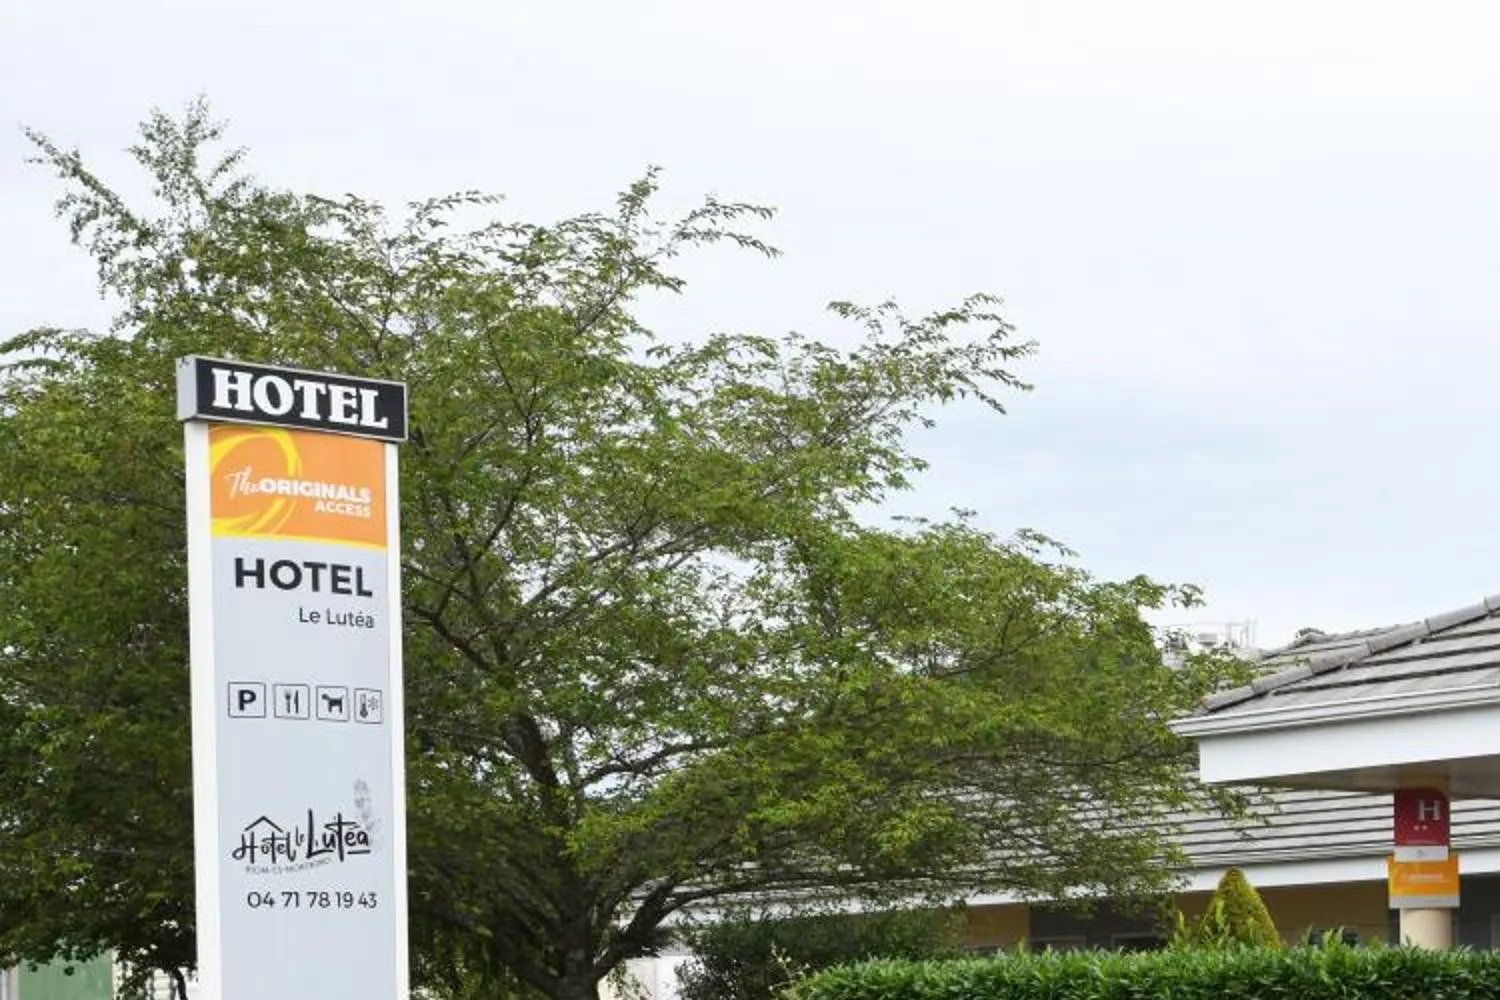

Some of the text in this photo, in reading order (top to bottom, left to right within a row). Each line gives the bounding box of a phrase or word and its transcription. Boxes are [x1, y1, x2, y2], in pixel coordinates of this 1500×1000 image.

[211, 367, 389, 430] HOTEL
[224, 465, 372, 504] The ORIGINALS
[314, 502, 371, 518] ACCESS
[234, 557, 373, 598] HOTEL
[299, 607, 375, 629] Le Lutéa
[238, 689, 257, 711] P
[1418, 800, 1440, 821] H
[247, 891, 377, 908] 04 71 78 19 43
